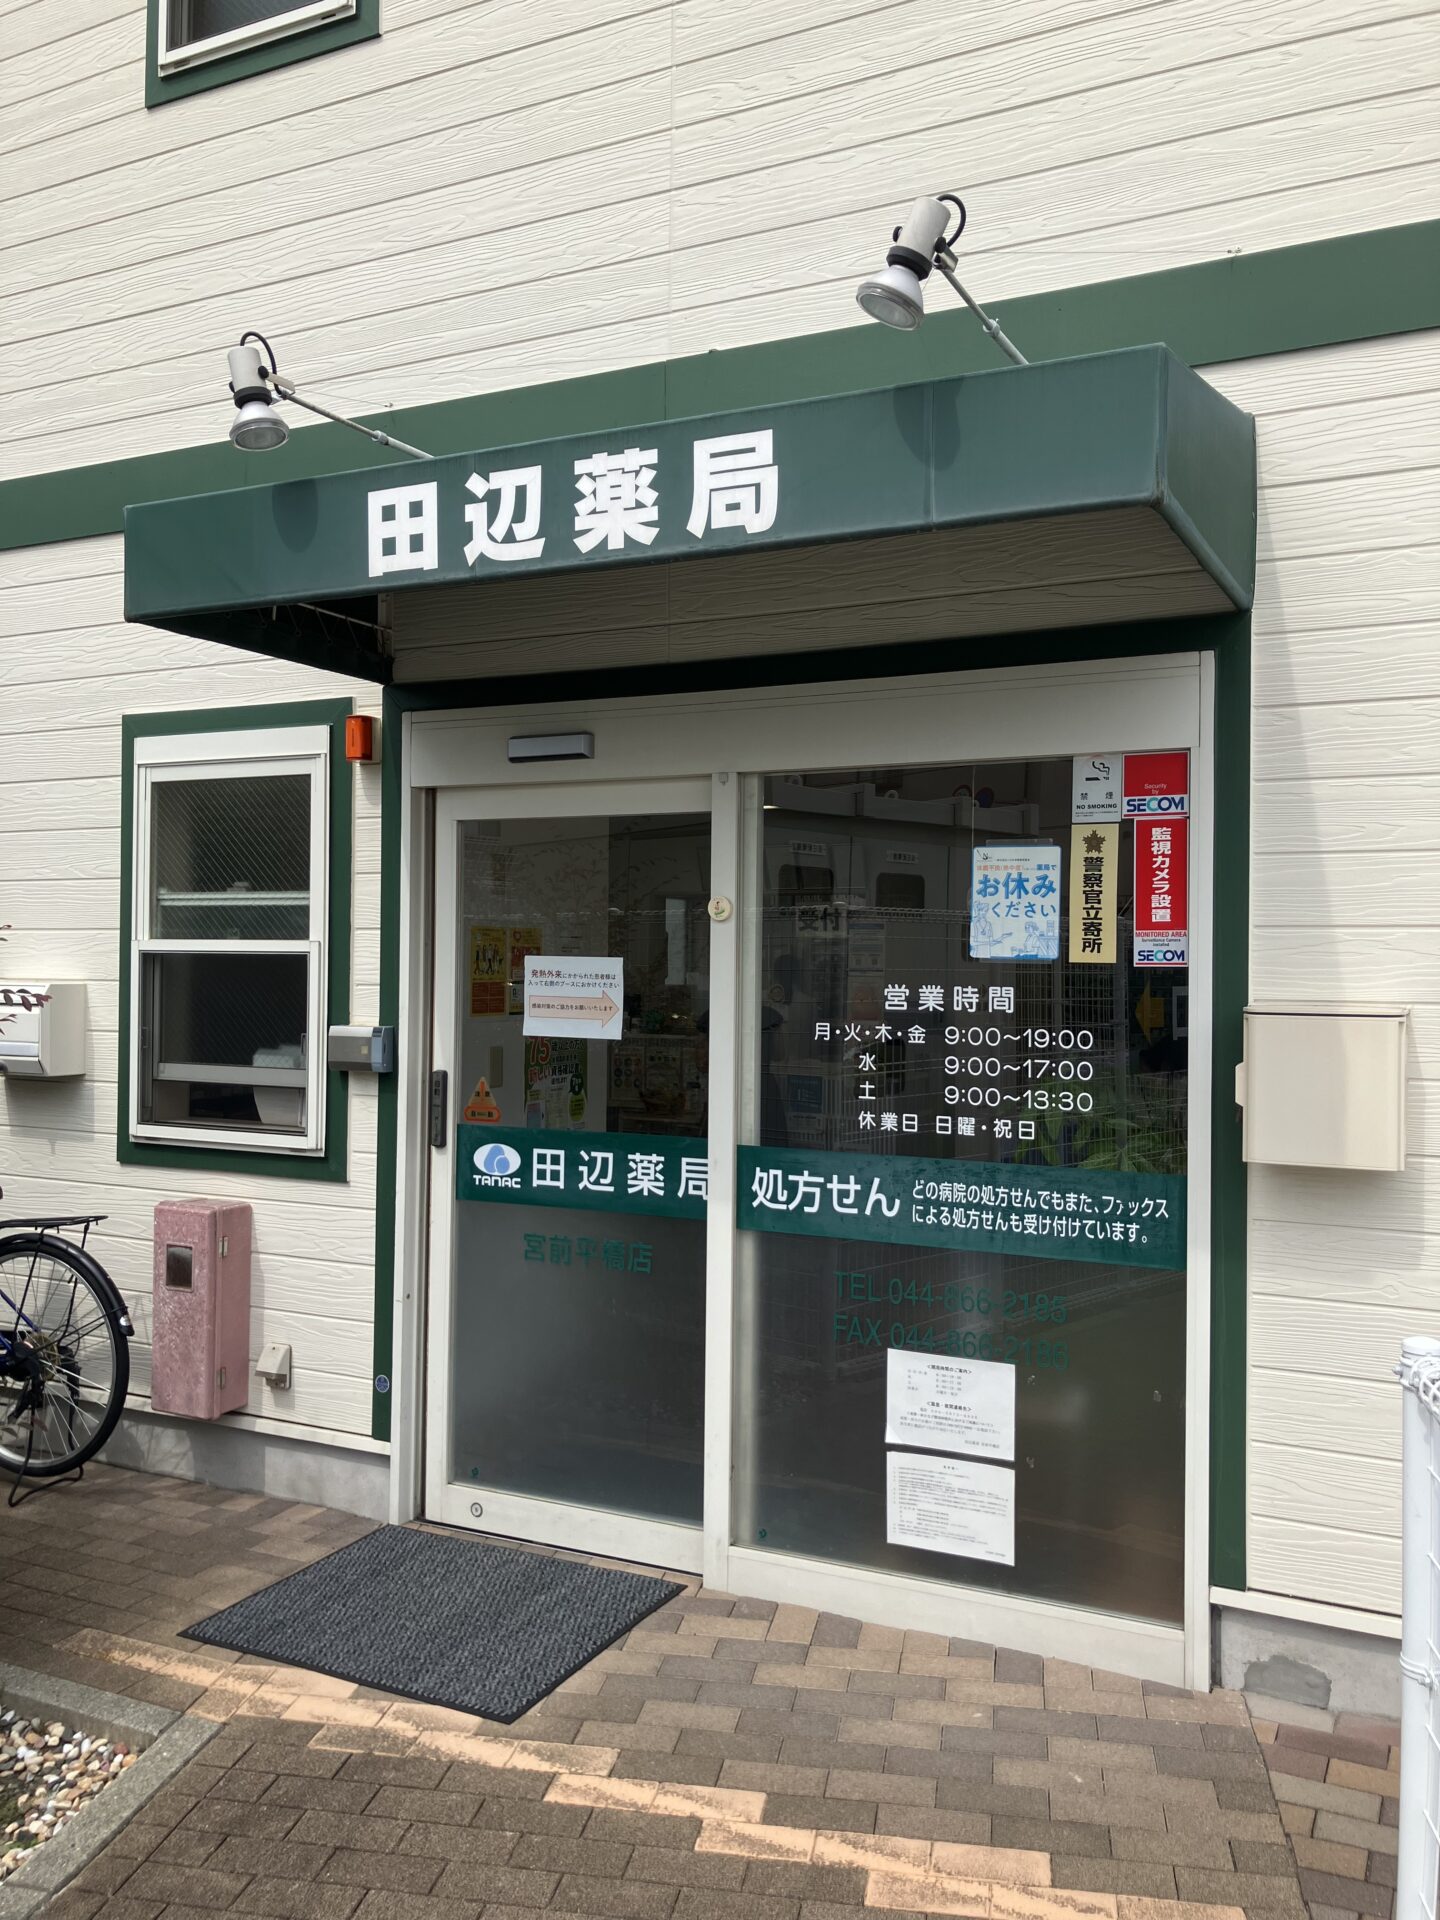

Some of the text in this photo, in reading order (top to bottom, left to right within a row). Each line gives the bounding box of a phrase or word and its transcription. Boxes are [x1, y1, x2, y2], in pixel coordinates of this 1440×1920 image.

[367, 428, 779, 578] 田辺薬局
[1126, 796, 1185, 813] SECOM
[975, 872, 1057, 900] お休み
[1151, 827, 1172, 923] 監視カメラ設置
[991, 901, 1057, 918] ください
[1081, 856, 1104, 954] 警察官立寄所
[1137, 949, 1185, 962] SECOM
[883, 984, 1015, 1014] 営業時間
[858, 1053, 877, 1072] 水
[858, 1081, 877, 1100] 土
[858, 1110, 1036, 1140] 休業日 日曜・祝日
[473, 1174, 522, 1189] TANAC
[532, 1147, 709, 1201] 田辺薬局
[751, 1167, 901, 1218] 処方せん
[911, 1179, 1170, 1219] どの病院の処方せんでもまた、ファックス
[911, 1204, 1150, 1244] による処方せんも受け付けています。
[833, 1270, 881, 1303] TEL
[832, 1311, 882, 1346] FAX
